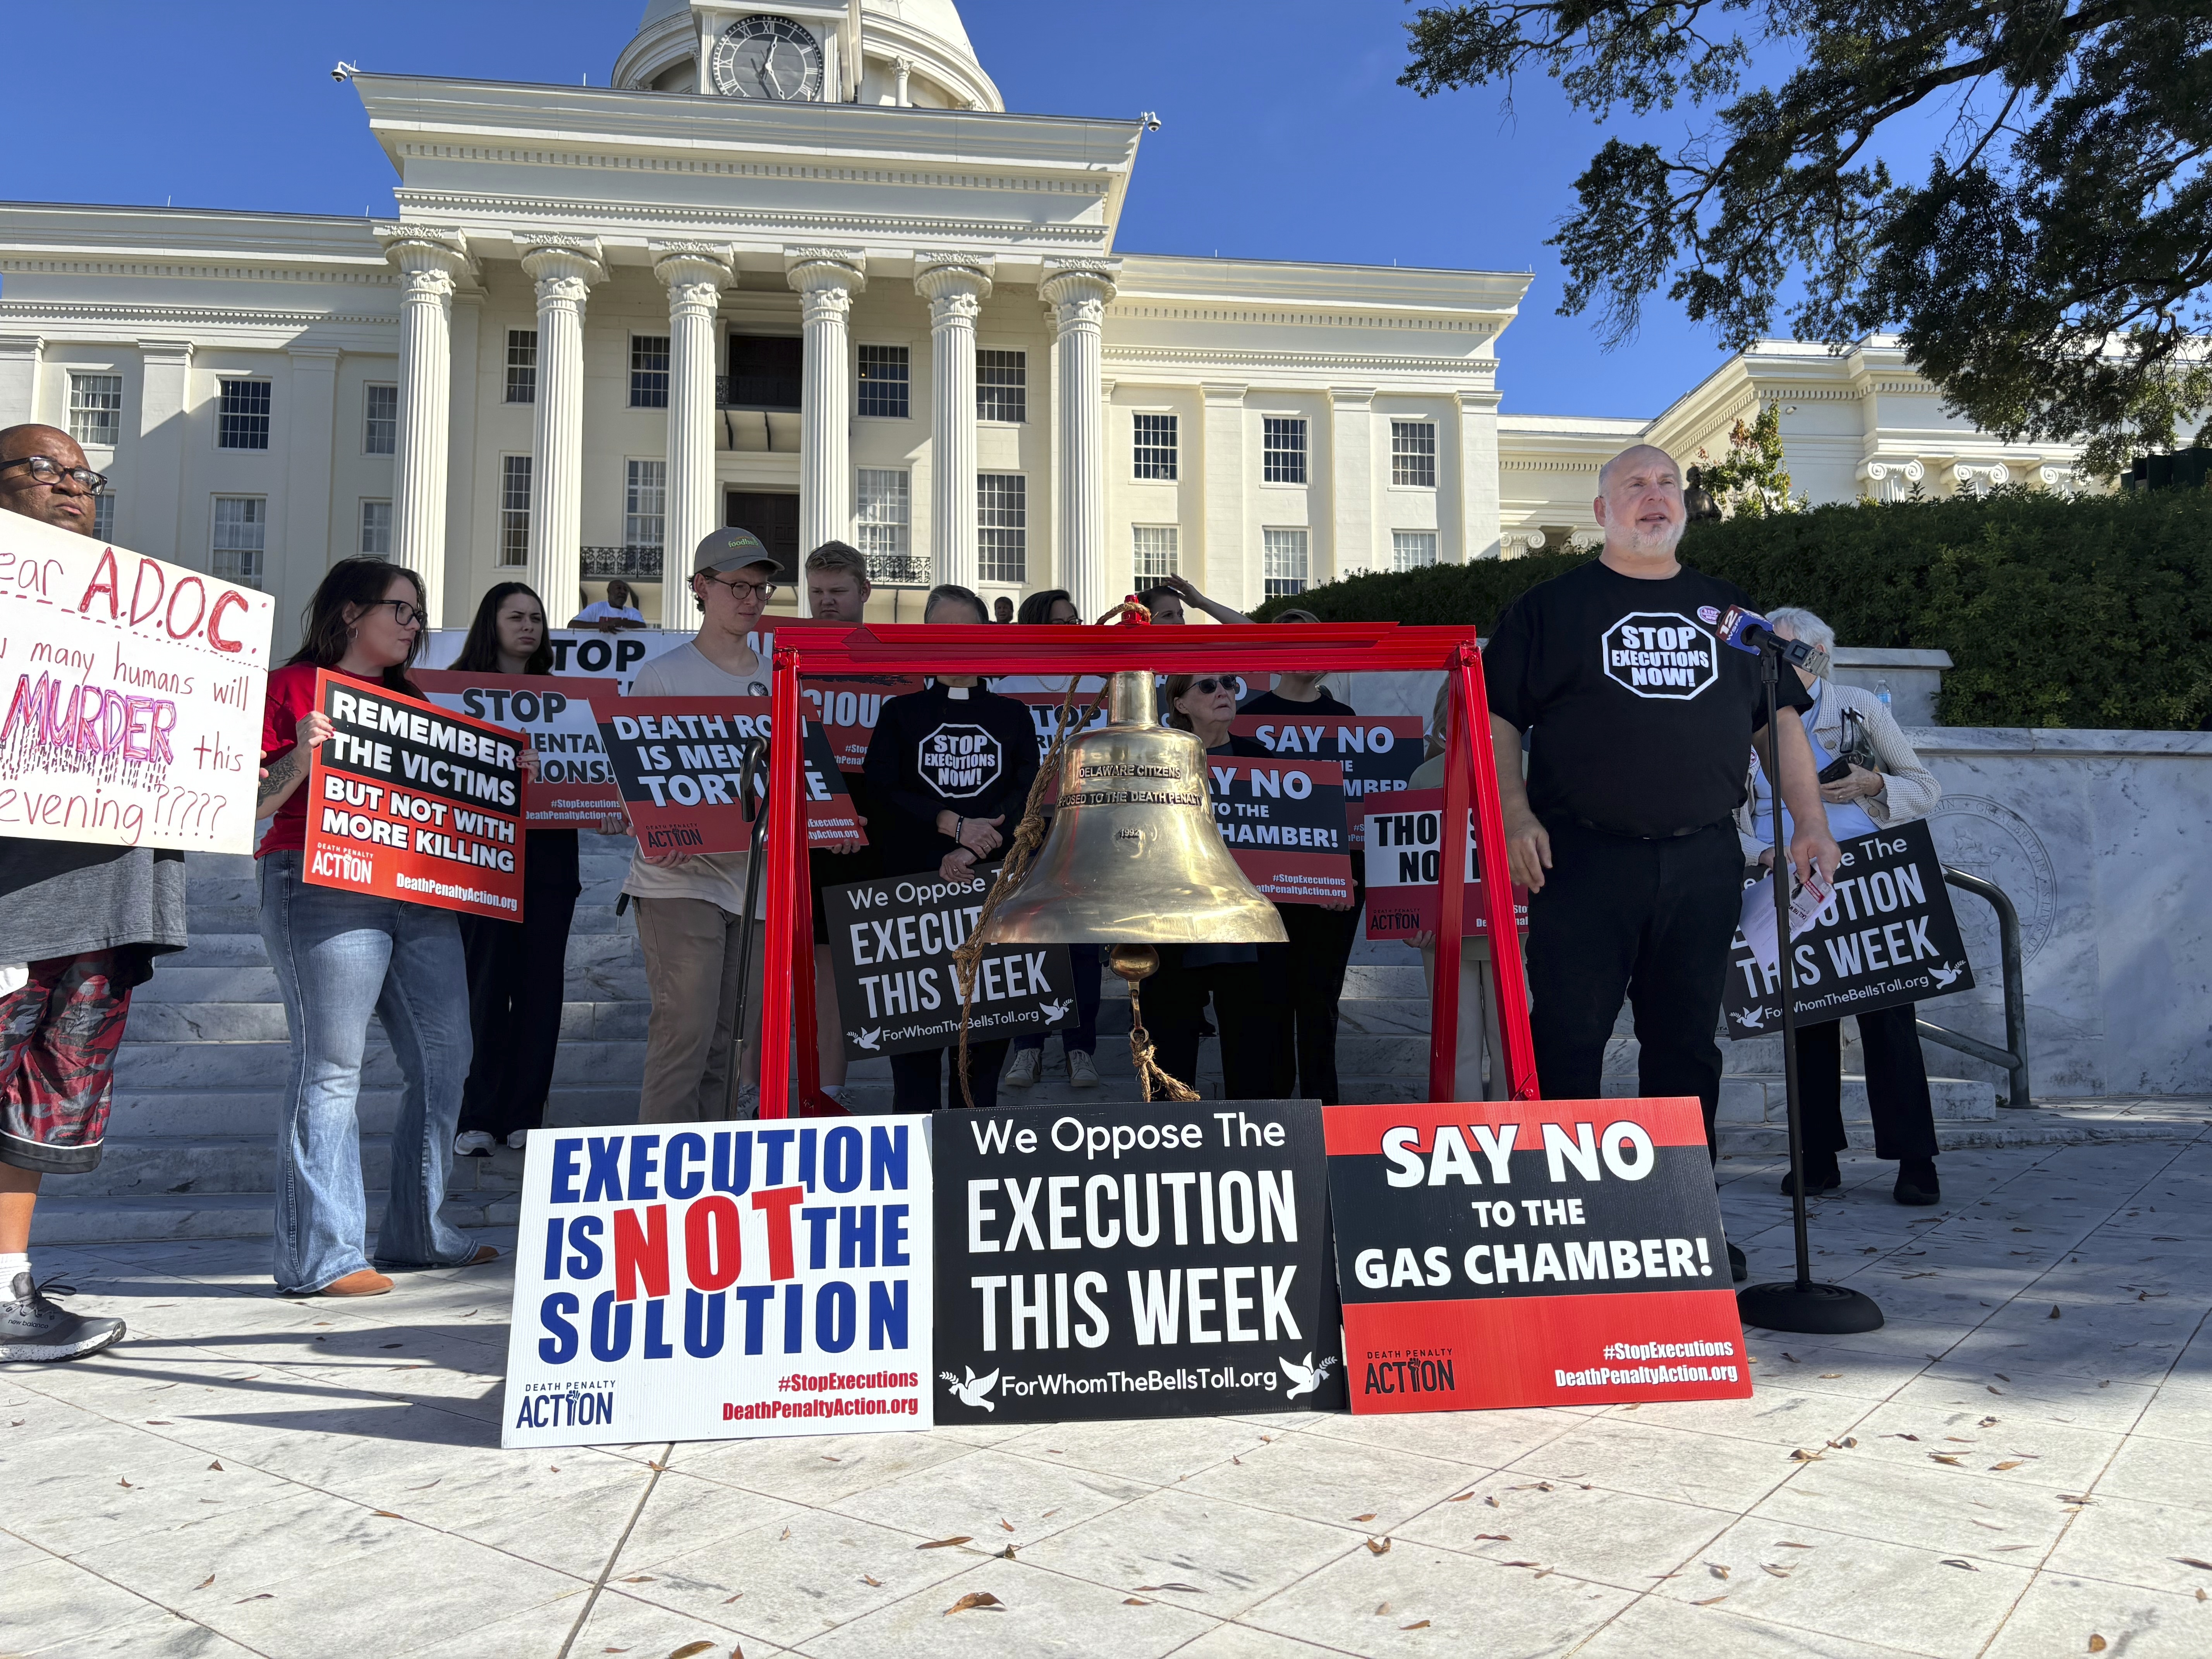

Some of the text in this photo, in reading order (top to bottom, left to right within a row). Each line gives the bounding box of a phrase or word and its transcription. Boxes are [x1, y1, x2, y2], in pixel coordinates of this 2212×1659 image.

[0, 553, 64, 596] ear
[1621, 625, 1697, 650] STOP
[550, 639, 646, 672] TOP
[1611, 649, 1709, 668] EXECUTIONS
[30, 642, 94, 685] many
[113, 641, 195, 694] humans
[214, 676, 249, 711] will
[1631, 667, 1695, 687] NOW!
[462, 687, 567, 723] STOP
[1025, 704, 1101, 727] TOP
[0, 670, 244, 772] MURDER this
[333, 690, 515, 771] REMEMBER
[612, 714, 808, 740] DEATH RO
[934, 735, 988, 755] STOP
[1255, 725, 1394, 754] SAY NO
[332, 731, 515, 806] THE VICTIMS
[636, 745, 672, 770] IS
[924, 753, 995, 770] EXECUTIONS
[1079, 764, 1181, 779] DELAWARE CITIZENS
[938, 768, 982, 787] NOW!
[1250, 768, 1312, 800] NO
[325, 775, 516, 845] BUT NOT WITH
[1090, 792, 1104, 804] TO
[1106, 792, 1127, 803] THE
[1131, 791, 1166, 803] DEATH
[1168, 792, 1205, 806] PENALTY
[1235, 803, 1270, 818] THE
[321, 807, 515, 874] MORE KILLING
[647, 827, 704, 848] ACTION
[1120, 829, 1140, 838] 1992
[1216, 823, 1338, 848] HAMBER!
[1374, 813, 1441, 847] THO
[317, 842, 374, 859] DEATH PENALTY
[1859, 837, 1908, 861] The
[311, 850, 373, 884] ACTION
[1273, 874, 1346, 886] #StopExecutions
[1399, 850, 1440, 883] NO
[397, 872, 517, 912] DeathPenaltyAction.org
[847, 887, 888, 910] We
[895, 876, 986, 906] Oppose
[1256, 884, 1347, 898] athPenaltyAction.org
[850, 905, 984, 966] EXECUT
[1370, 912, 1420, 930] ACTION
[1824, 915, 1940, 979] WEEK
[859, 967, 941, 1018] THIS
[1764, 975, 1929, 1019] FohomTheBellsToll.org
[970, 1111, 1286, 1160] We Oppose The
[550, 1125, 909, 1204] EXECUTION
[1380, 1120, 1655, 1188] SAY NO
[967, 1170, 1298, 1254] EXECUTION
[1472, 1198, 1586, 1228] TO THE
[544, 1185, 910, 1302] IS NOT THE
[1354, 1237, 1713, 1289] GAS CHAMBER!
[538, 1279, 909, 1365] SOLUTION
[971, 1265, 1303, 1352] THIS WEEK
[1367, 1348, 1453, 1359] DEATH PENALTY
[1603, 1340, 1735, 1362] #StopExecutions
[525, 1379, 616, 1392] DEATH PENALTY
[778, 1370, 919, 1393] #StopExecutions
[1002, 1367, 1277, 1397] ForWhomTheBellsToll.org
[1364, 1358, 1455, 1395] ACTION
[1554, 1365, 1738, 1388] DeathPenaltyAction.org
[516, 1389, 613, 1429] ACTION
[722, 1398, 919, 1421] DeathPenaltyAction.org
